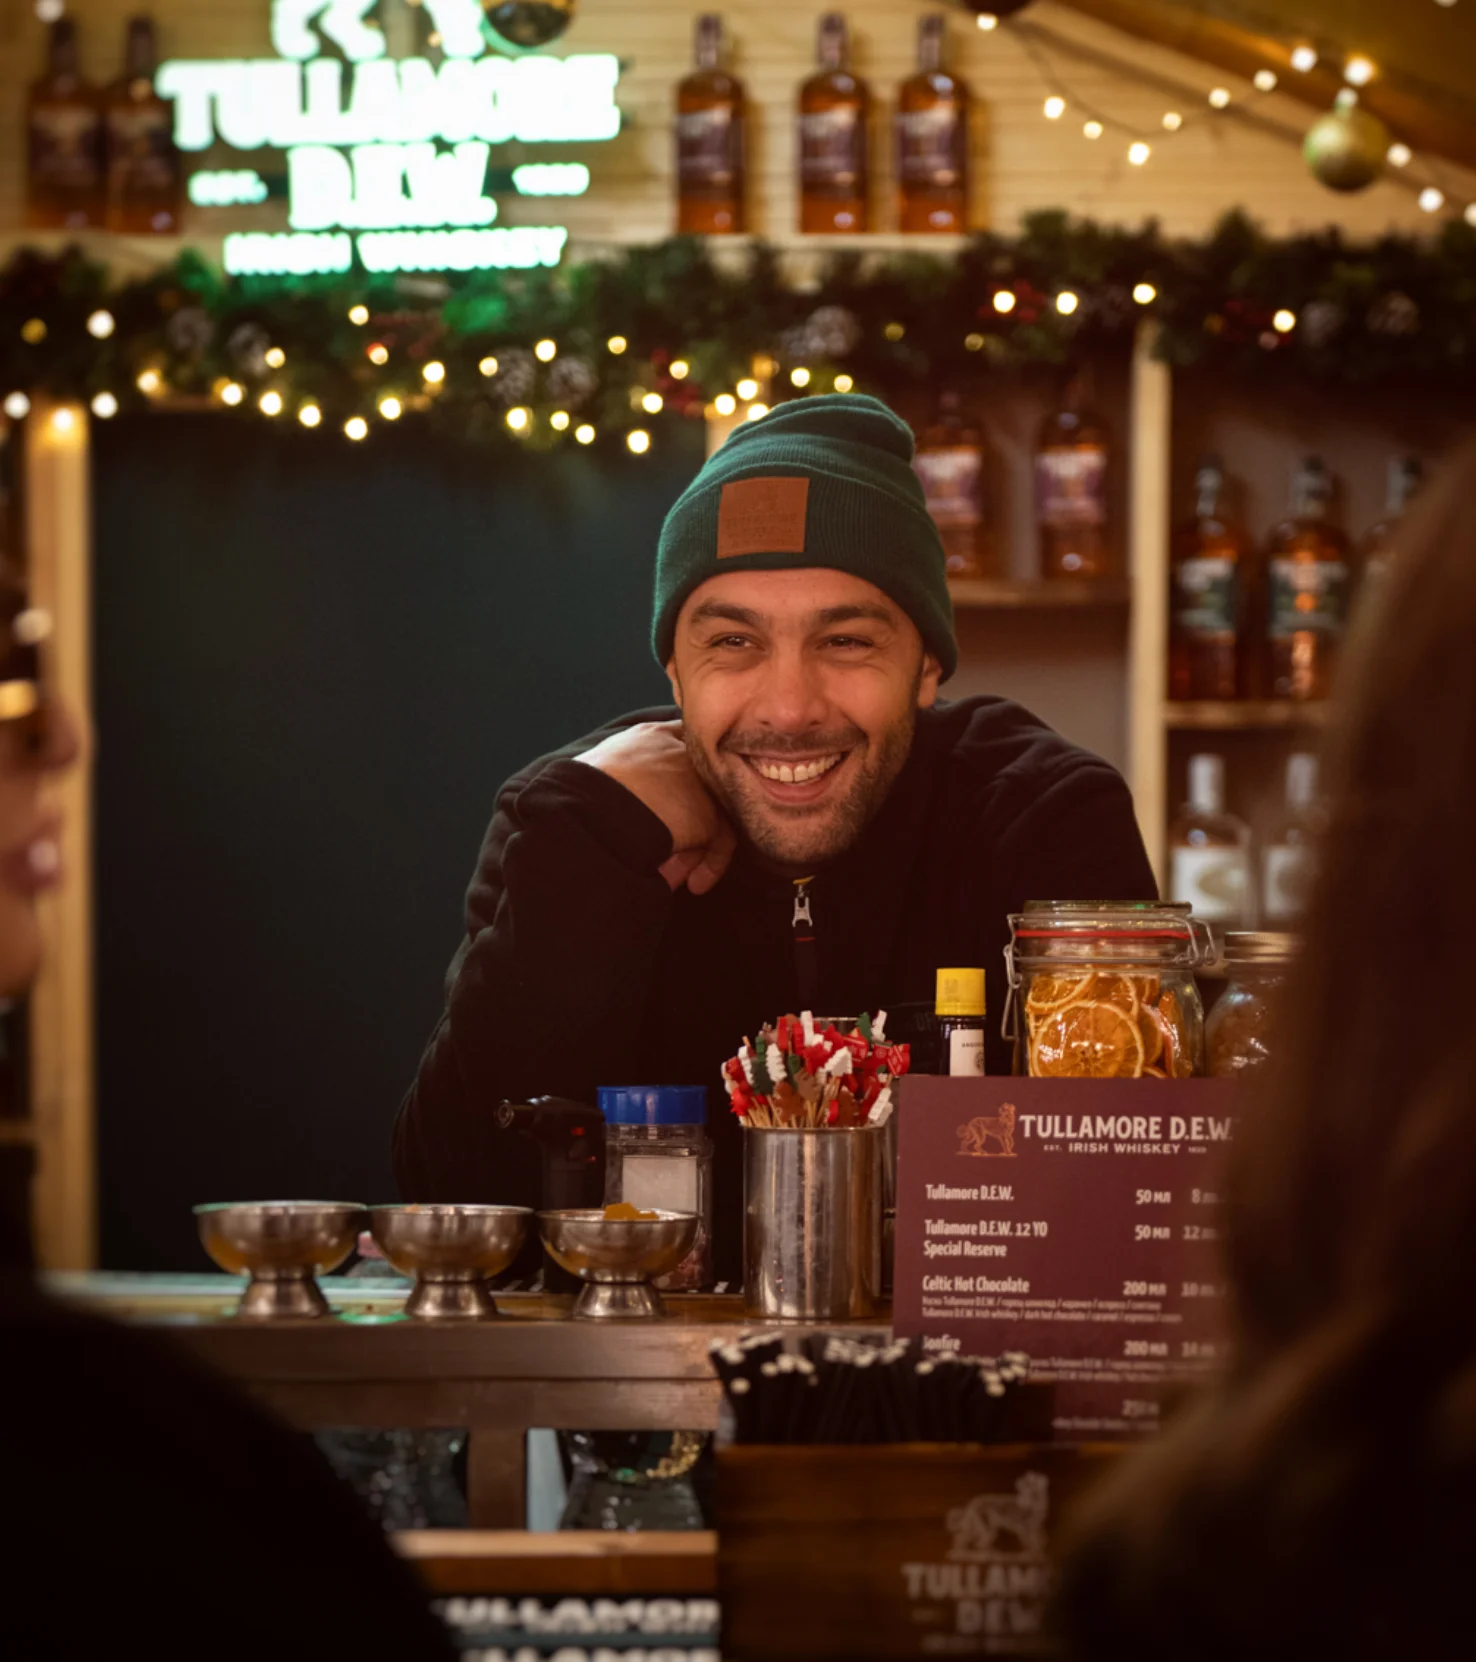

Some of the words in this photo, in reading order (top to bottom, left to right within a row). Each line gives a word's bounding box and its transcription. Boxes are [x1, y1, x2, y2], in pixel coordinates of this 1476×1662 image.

[1018, 1115, 1161, 1139] TULLAMORE
[1068, 1142, 1109, 1153] IRISH
[1113, 1143, 1181, 1155] WHISKEY
[925, 1184, 979, 1200] Tullamore
[980, 1185, 1015, 1201] D.E.W.
[1135, 1189, 1152, 1205] 50
[1191, 1188, 1201, 1205] 8
[924, 1219, 978, 1235] Tullamore
[979, 1220, 1013, 1236] D.E.W.
[1015, 1222, 1031, 1237] 12
[1032, 1221, 1048, 1237] YO
[1135, 1224, 1151, 1240] 50
[1183, 1225, 1200, 1240] 12
[923, 1240, 962, 1259] Special
[963, 1241, 1008, 1256] Reserve
[922, 1275, 952, 1291] Celtic
[954, 1276, 974, 1292] Hot
[975, 1276, 1030, 1293] Chocolate
[1123, 1281, 1147, 1297] 200
